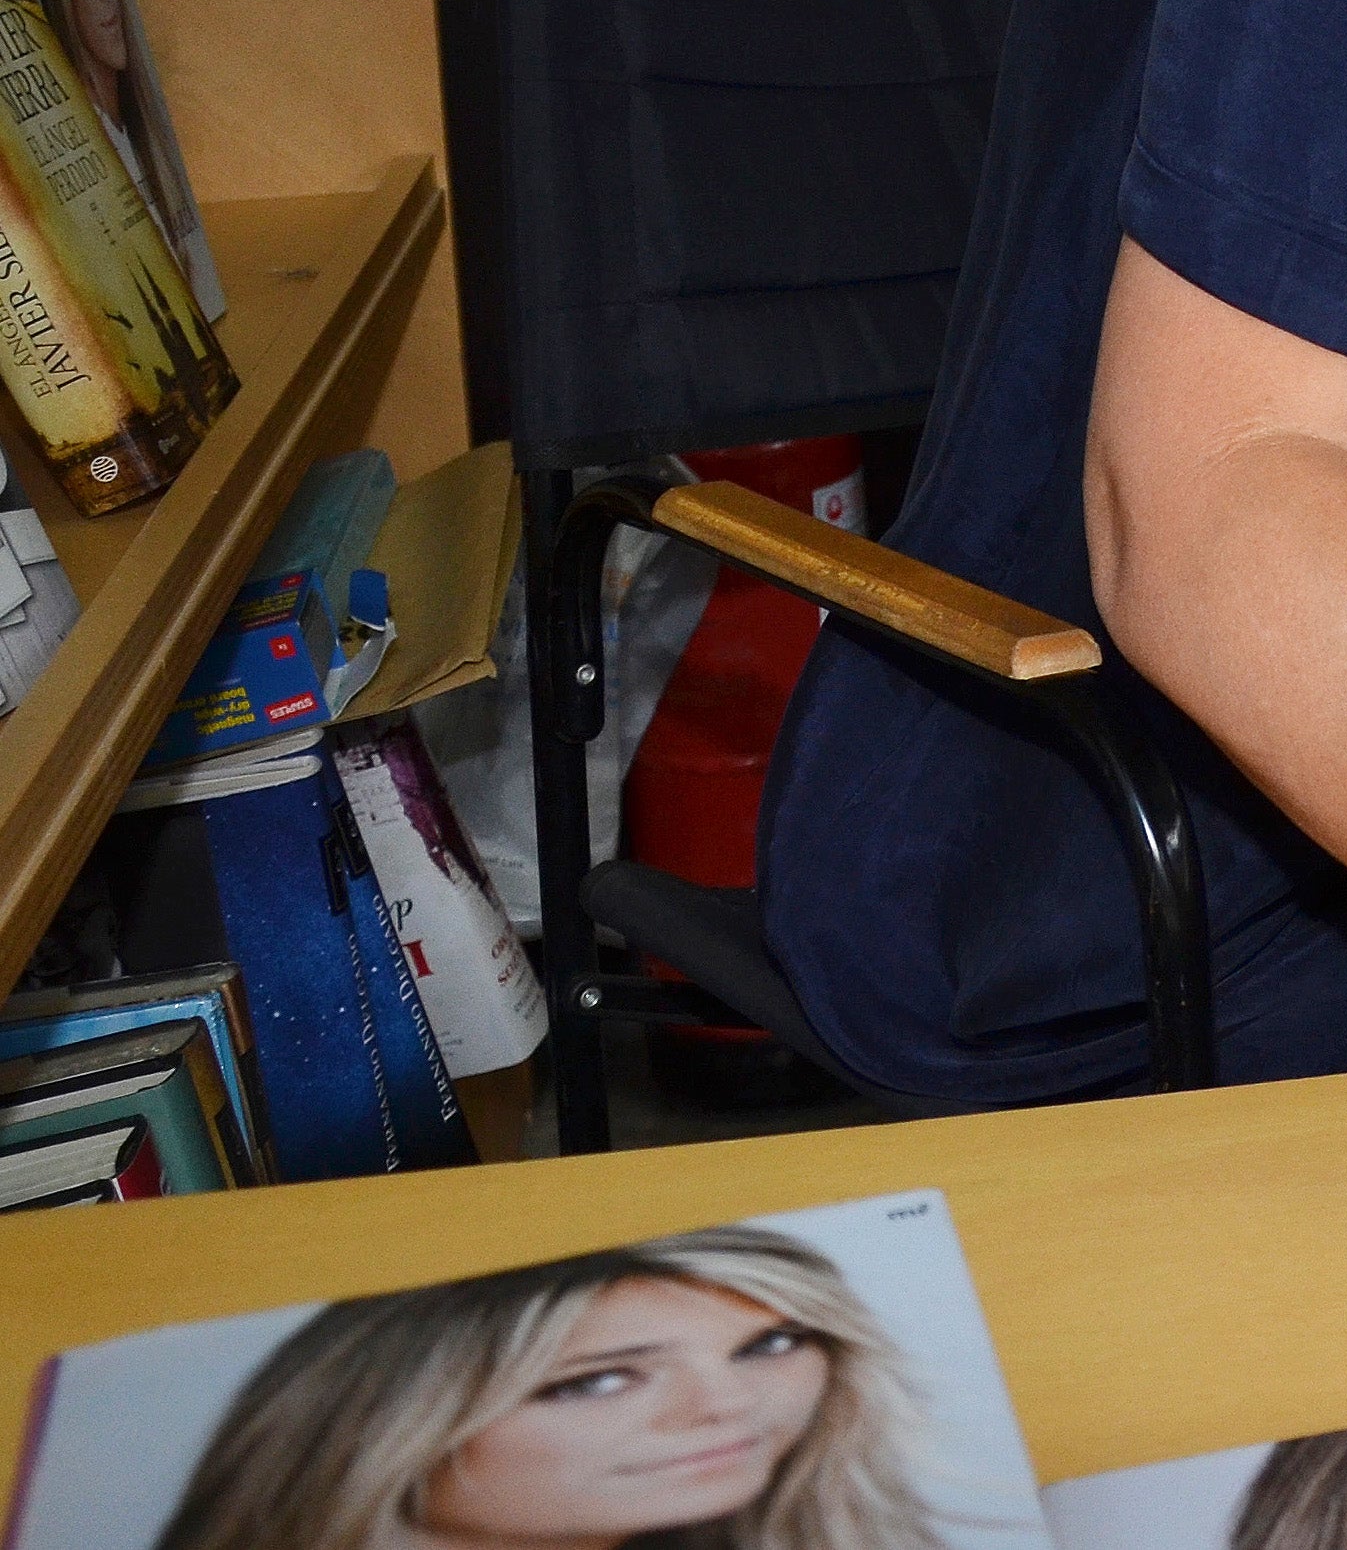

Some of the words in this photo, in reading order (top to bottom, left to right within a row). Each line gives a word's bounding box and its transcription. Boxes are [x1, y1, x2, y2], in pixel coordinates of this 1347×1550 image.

[0, 61, 70, 106] IERRA
[0, 300, 36, 368] ÁNGE
[9, 280, 92, 391] JAVIER
[30, 370, 52, 399] EL
[269, 697, 315, 719] STAPLES
[372, 893, 414, 1001] DELGADO
[409, 1002, 458, 1123] FERNANDO
[370, 1047, 400, 1172] FERNANDO
